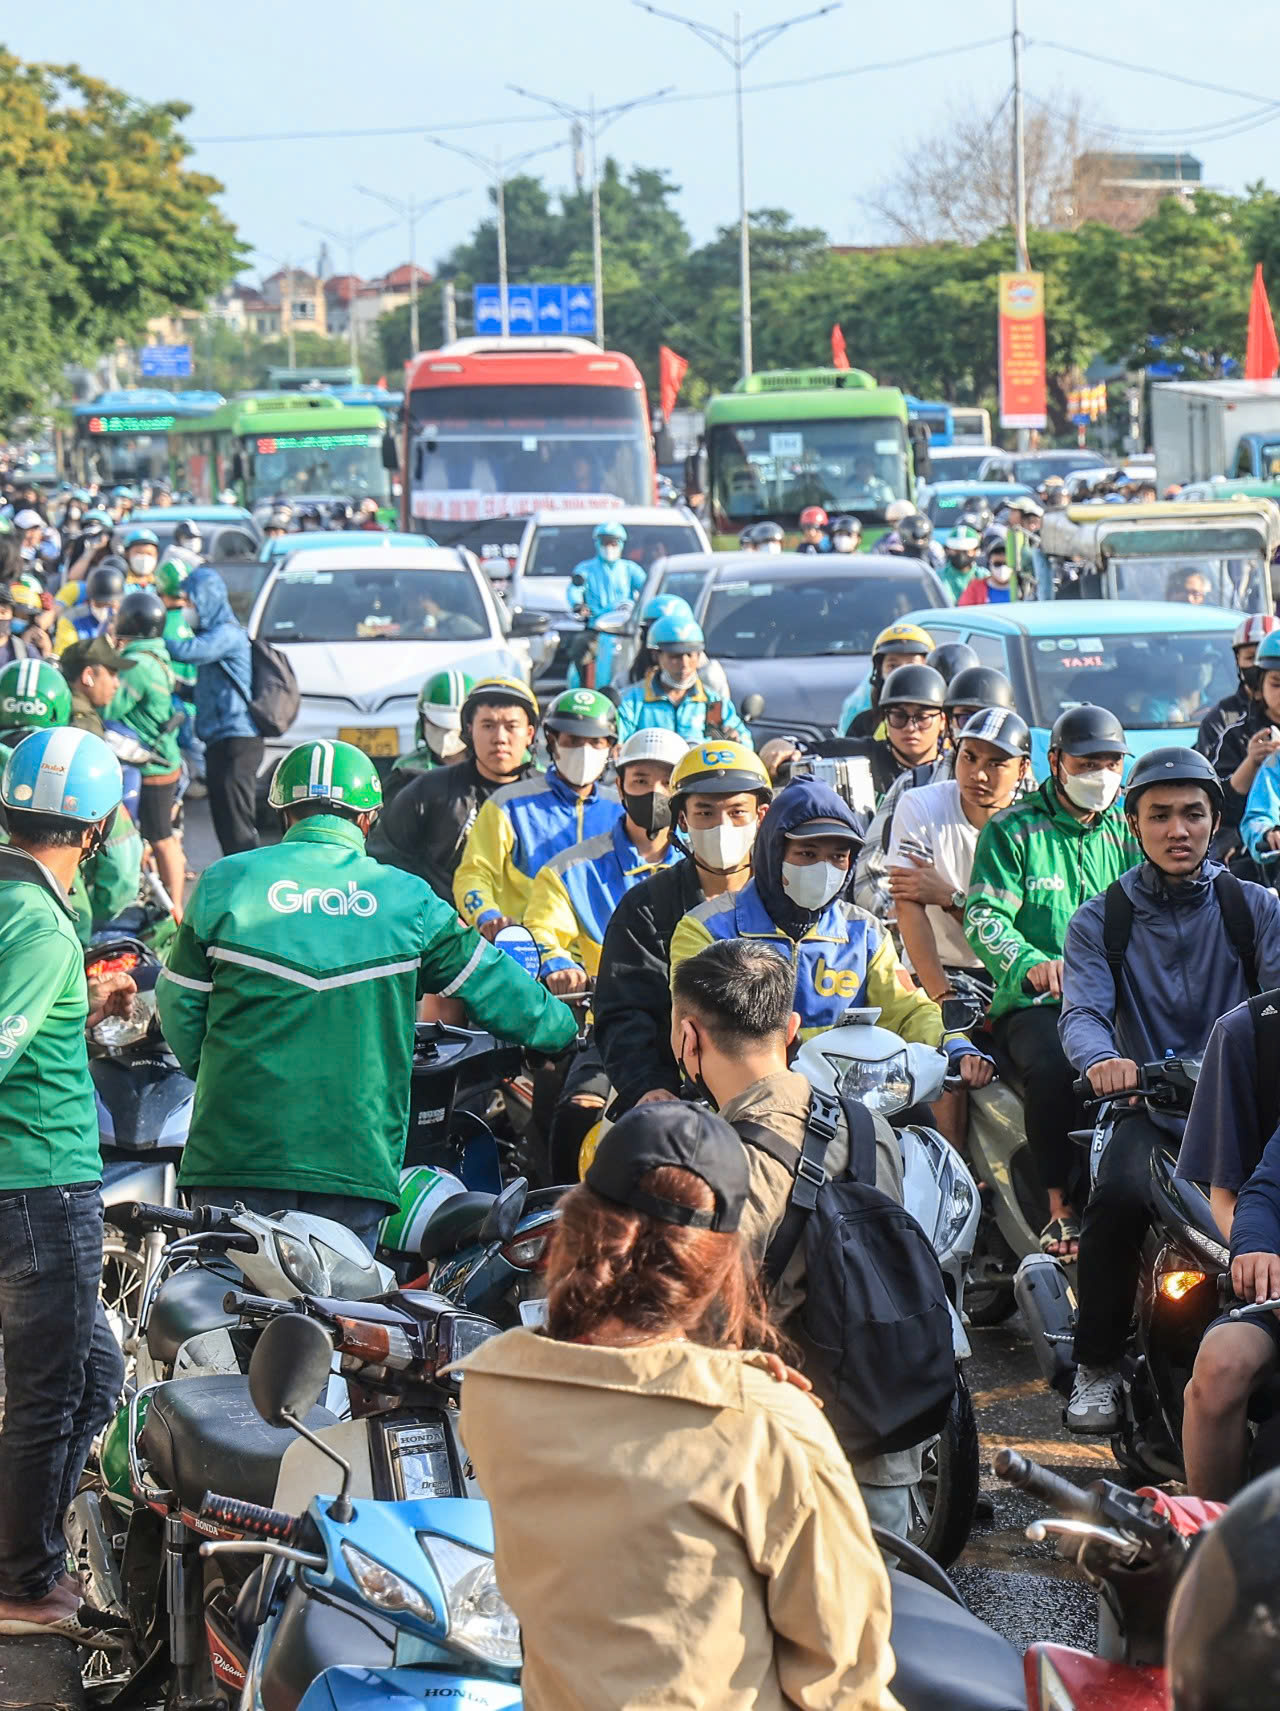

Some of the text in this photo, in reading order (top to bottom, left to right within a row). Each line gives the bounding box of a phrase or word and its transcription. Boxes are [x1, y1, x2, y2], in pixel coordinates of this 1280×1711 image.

[1061, 656, 1103, 668] TAXI
[3, 697, 48, 716] Grab
[702, 749, 735, 766] be
[1025, 873, 1065, 891] Grab
[267, 880, 378, 917] Grab
[814, 957, 860, 998] be
[131, 1060, 168, 1068] HONDA
[400, 1433, 444, 1444] HONDA
[195, 1518, 219, 1536] HONDA
[213, 1652, 246, 1679] Dream
